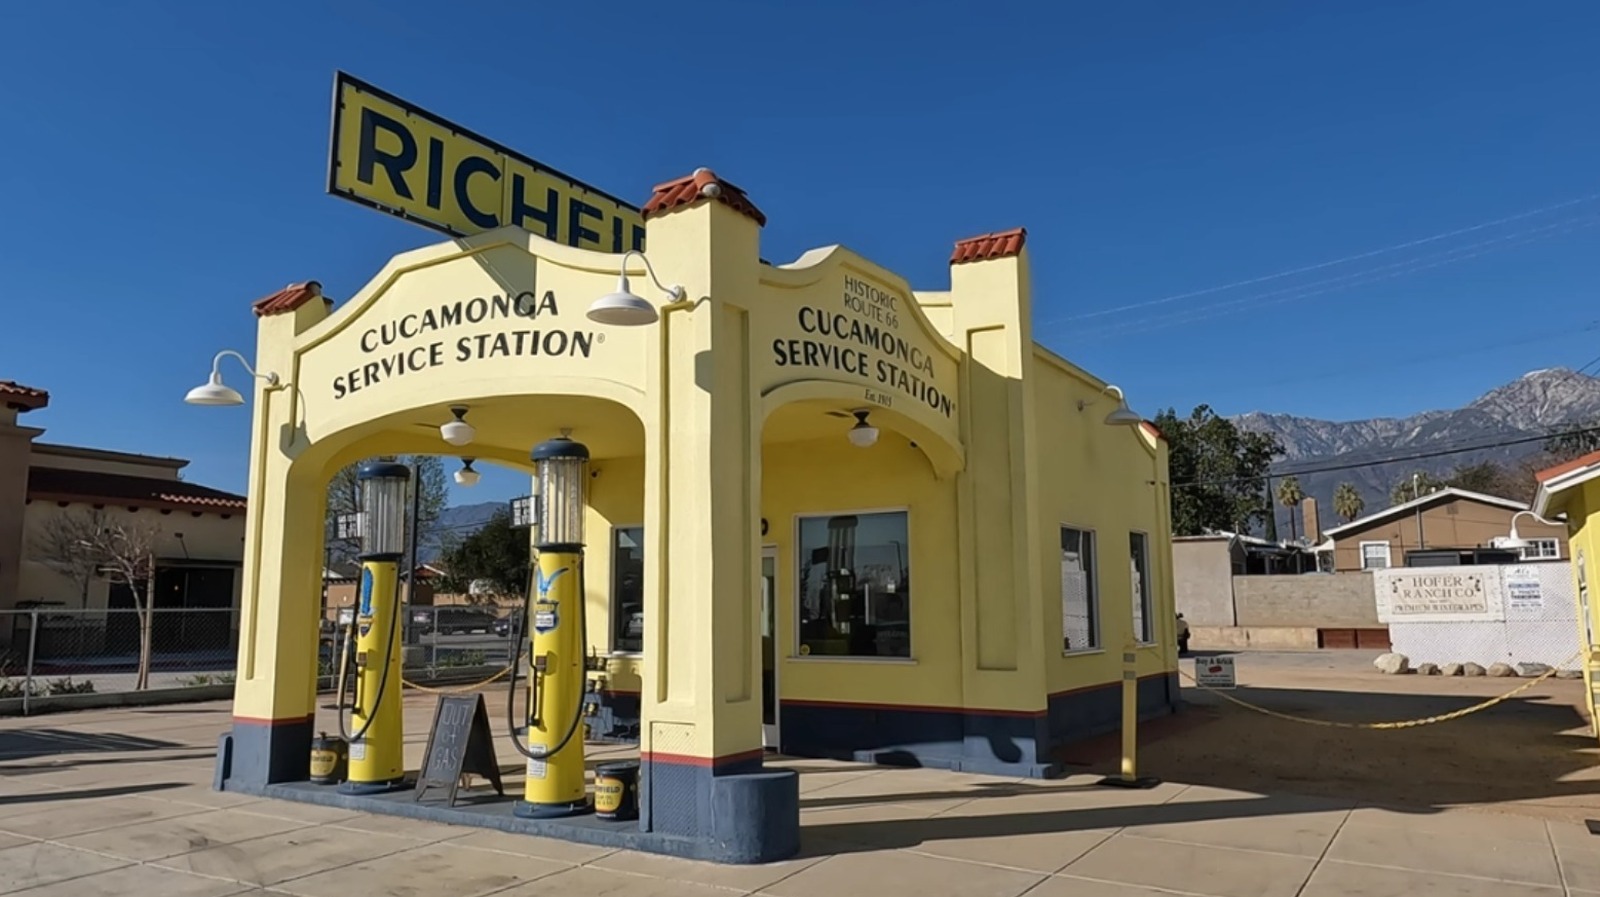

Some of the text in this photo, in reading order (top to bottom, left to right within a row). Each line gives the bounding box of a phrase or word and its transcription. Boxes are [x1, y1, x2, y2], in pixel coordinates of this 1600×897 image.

[844, 275, 897, 312] HISTORIC
[844, 293, 899, 329] ROUTE 66
[360, 290, 558, 353] CUCAMONGA
[773, 339, 869, 377] SERVICE
[798, 306, 934, 379] CUCAMONGA
[332, 342, 444, 400] SERVICE
[1403, 588, 1451, 598] RANCH
[1413, 576, 1462, 587] HOFER
[442, 703, 470, 726] OUT
[433, 746, 459, 771] GAS
